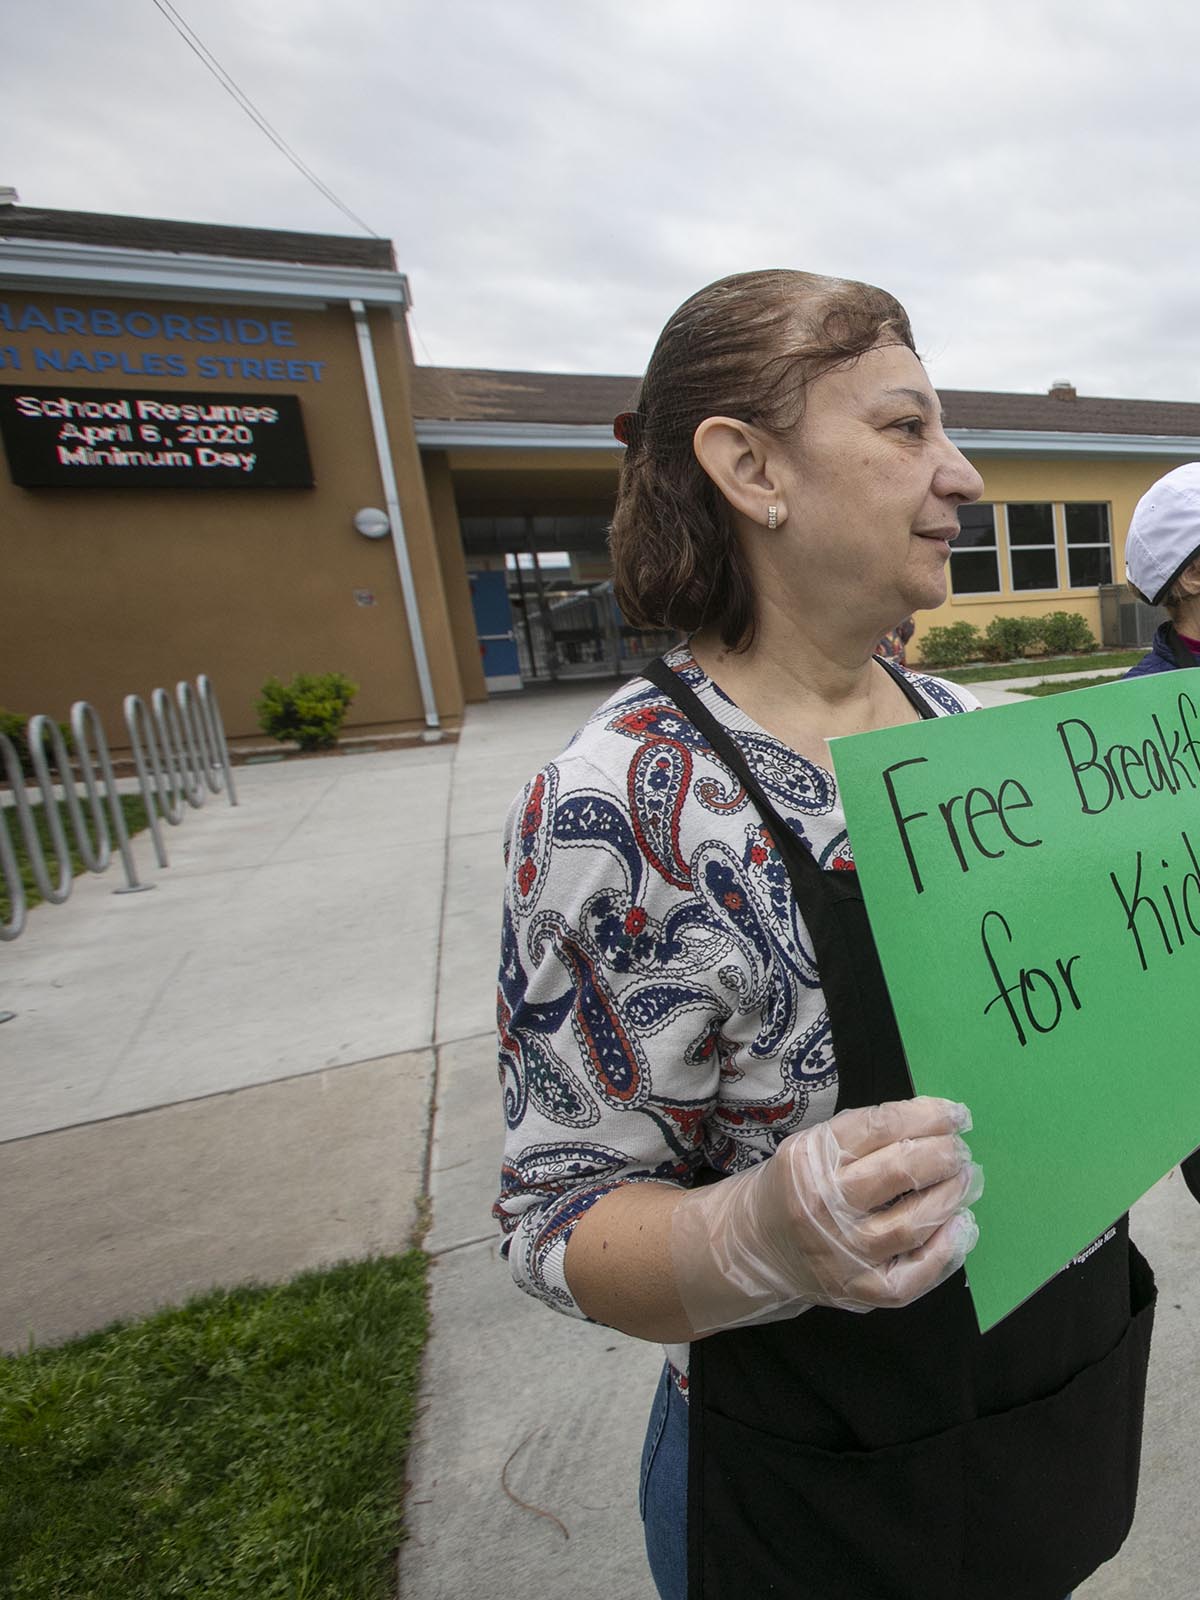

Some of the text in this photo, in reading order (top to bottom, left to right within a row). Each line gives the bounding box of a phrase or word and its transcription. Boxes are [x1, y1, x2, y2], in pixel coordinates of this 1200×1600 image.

[34, 347, 189, 377] NAPLES
[197, 355, 326, 382] STREET
[15, 396, 279, 423] School Resumes
[57, 422, 253, 448] April 6, 2020
[56, 446, 256, 472] Minimum Day
[882, 756, 1043, 895] Free
[981, 910, 1081, 1047] for
